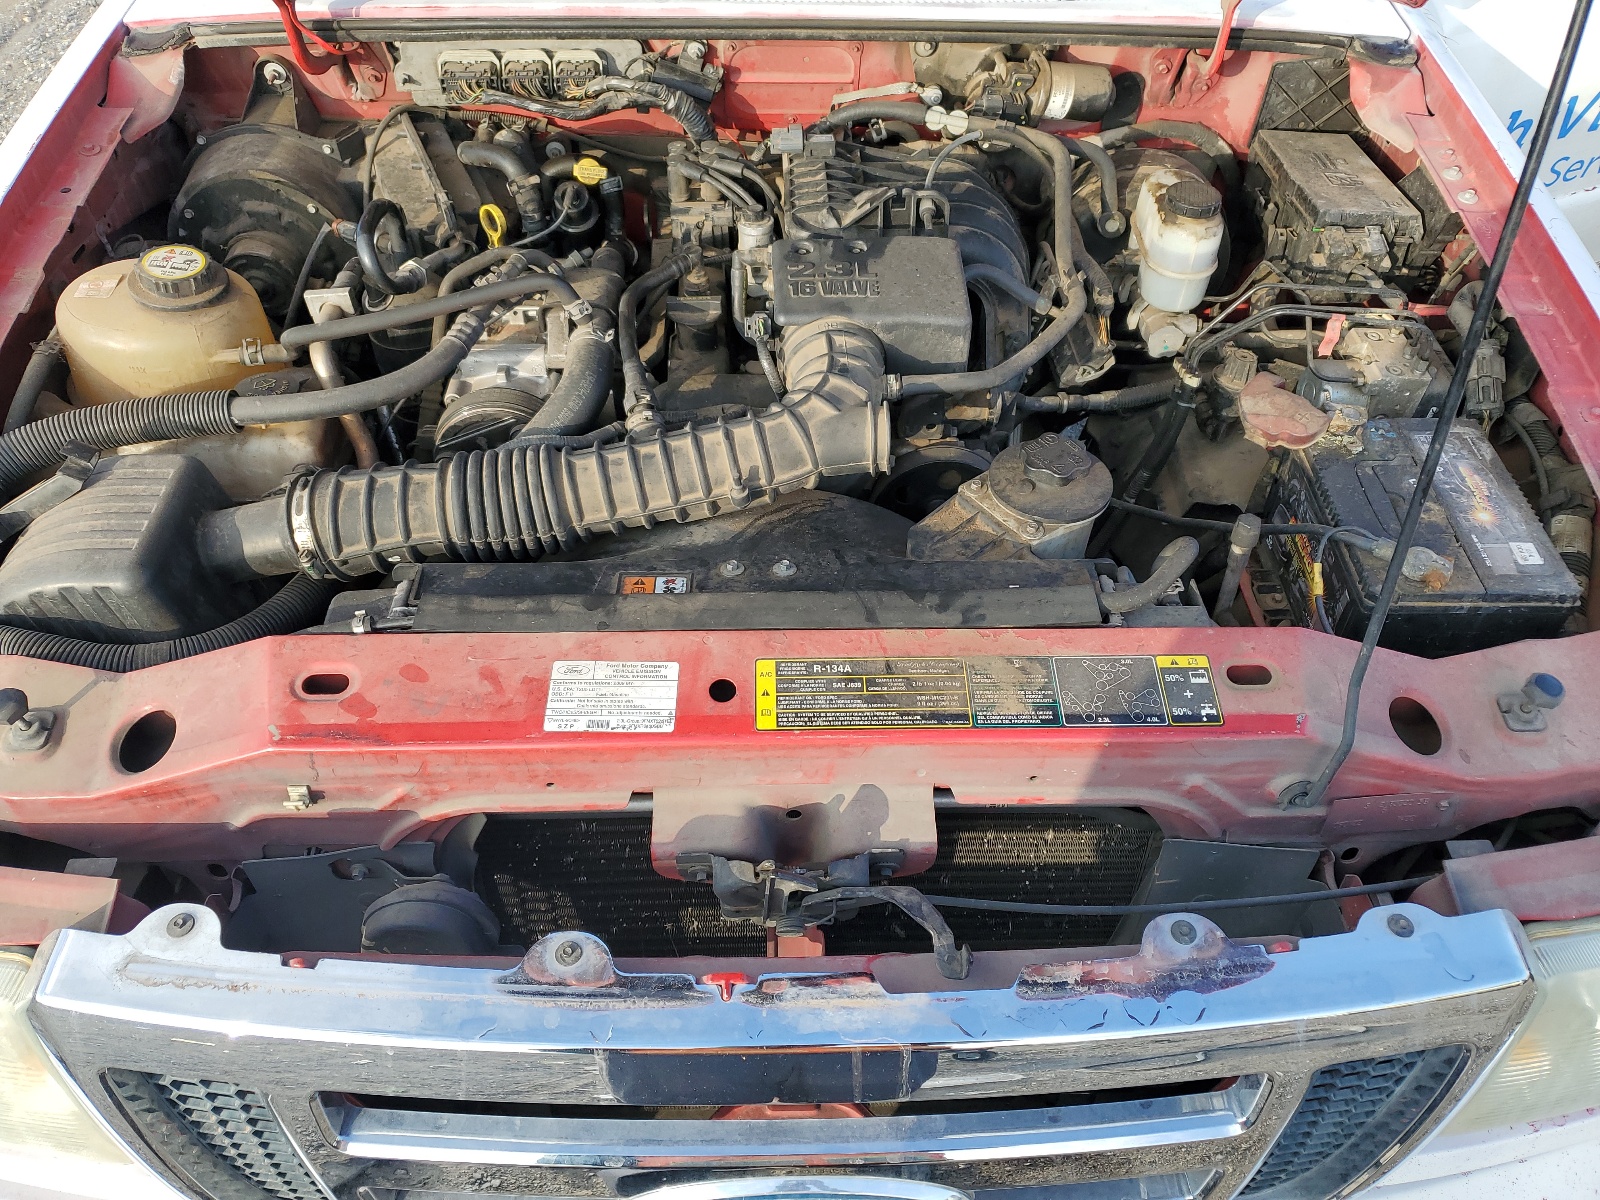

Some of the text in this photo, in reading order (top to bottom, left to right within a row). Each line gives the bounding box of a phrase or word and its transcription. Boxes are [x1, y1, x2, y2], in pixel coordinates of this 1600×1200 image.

[1544, 156, 1600, 187] Ser
[787, 261, 878, 280] 2.3L
[789, 280, 880, 298] 16 VALVE
[813, 664, 852, 673] R-134A
[1164, 674, 1184, 682] 50%
[1172, 707, 1192, 716] 50%
